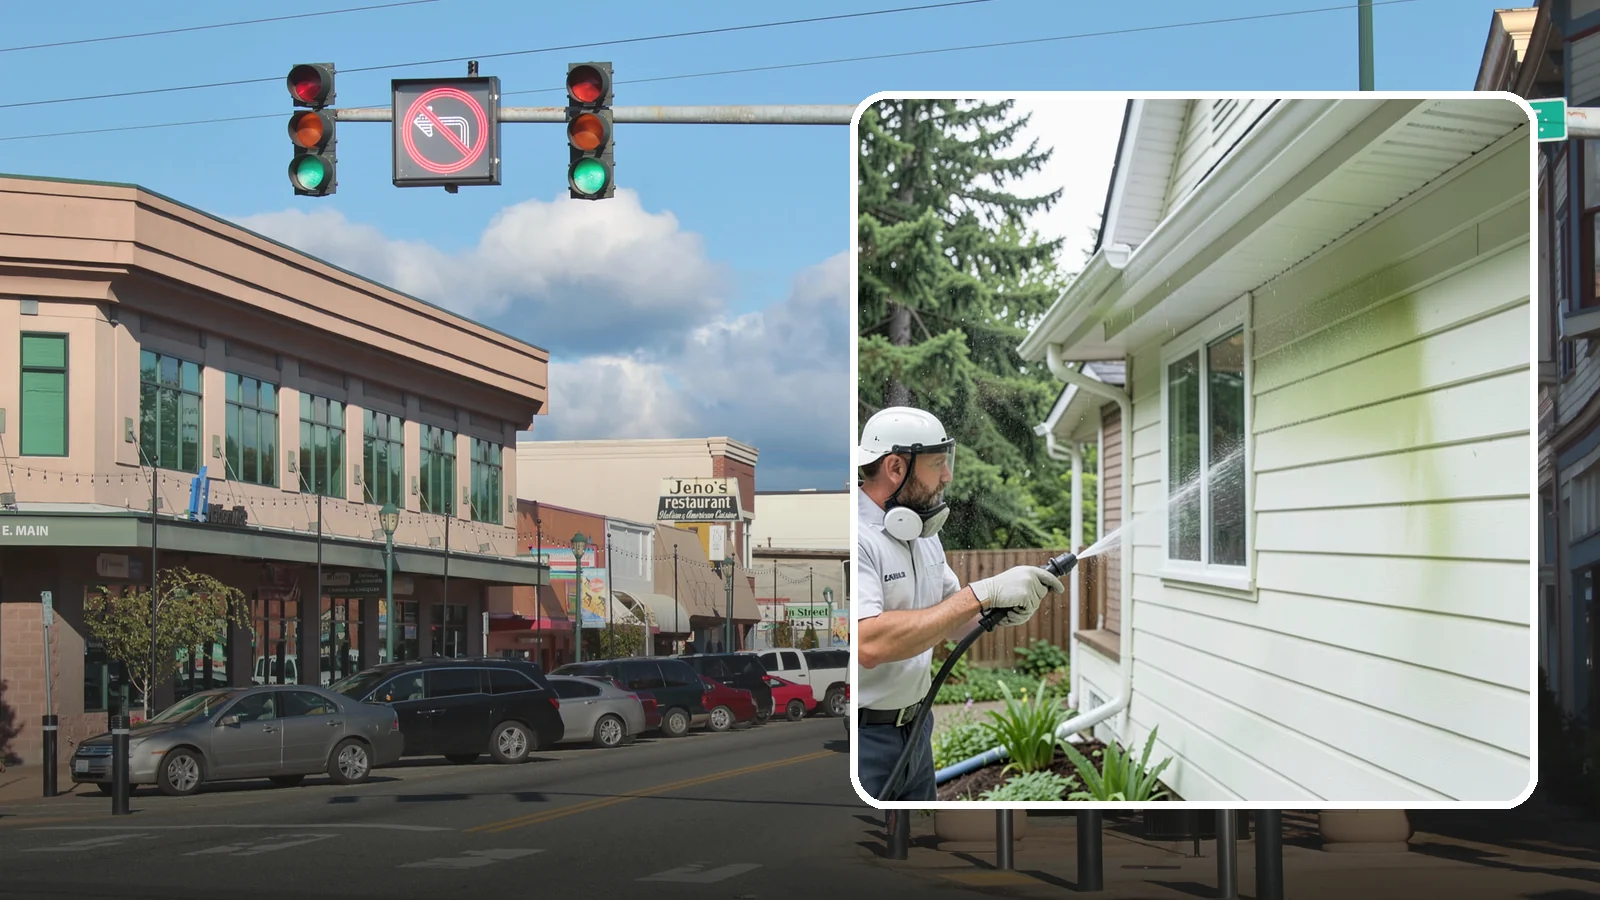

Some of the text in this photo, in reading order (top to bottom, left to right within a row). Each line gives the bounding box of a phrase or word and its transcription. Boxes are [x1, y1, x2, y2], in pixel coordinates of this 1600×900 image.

[670, 480, 727, 494] Jeno's
[665, 496, 731, 509] restaurant
[658, 510, 681, 519] Italian
[686, 510, 714, 519] American
[715, 510, 737, 519] Cuisine
[2, 525, 49, 536] E. MAIN
[797, 607, 828, 617] Street
